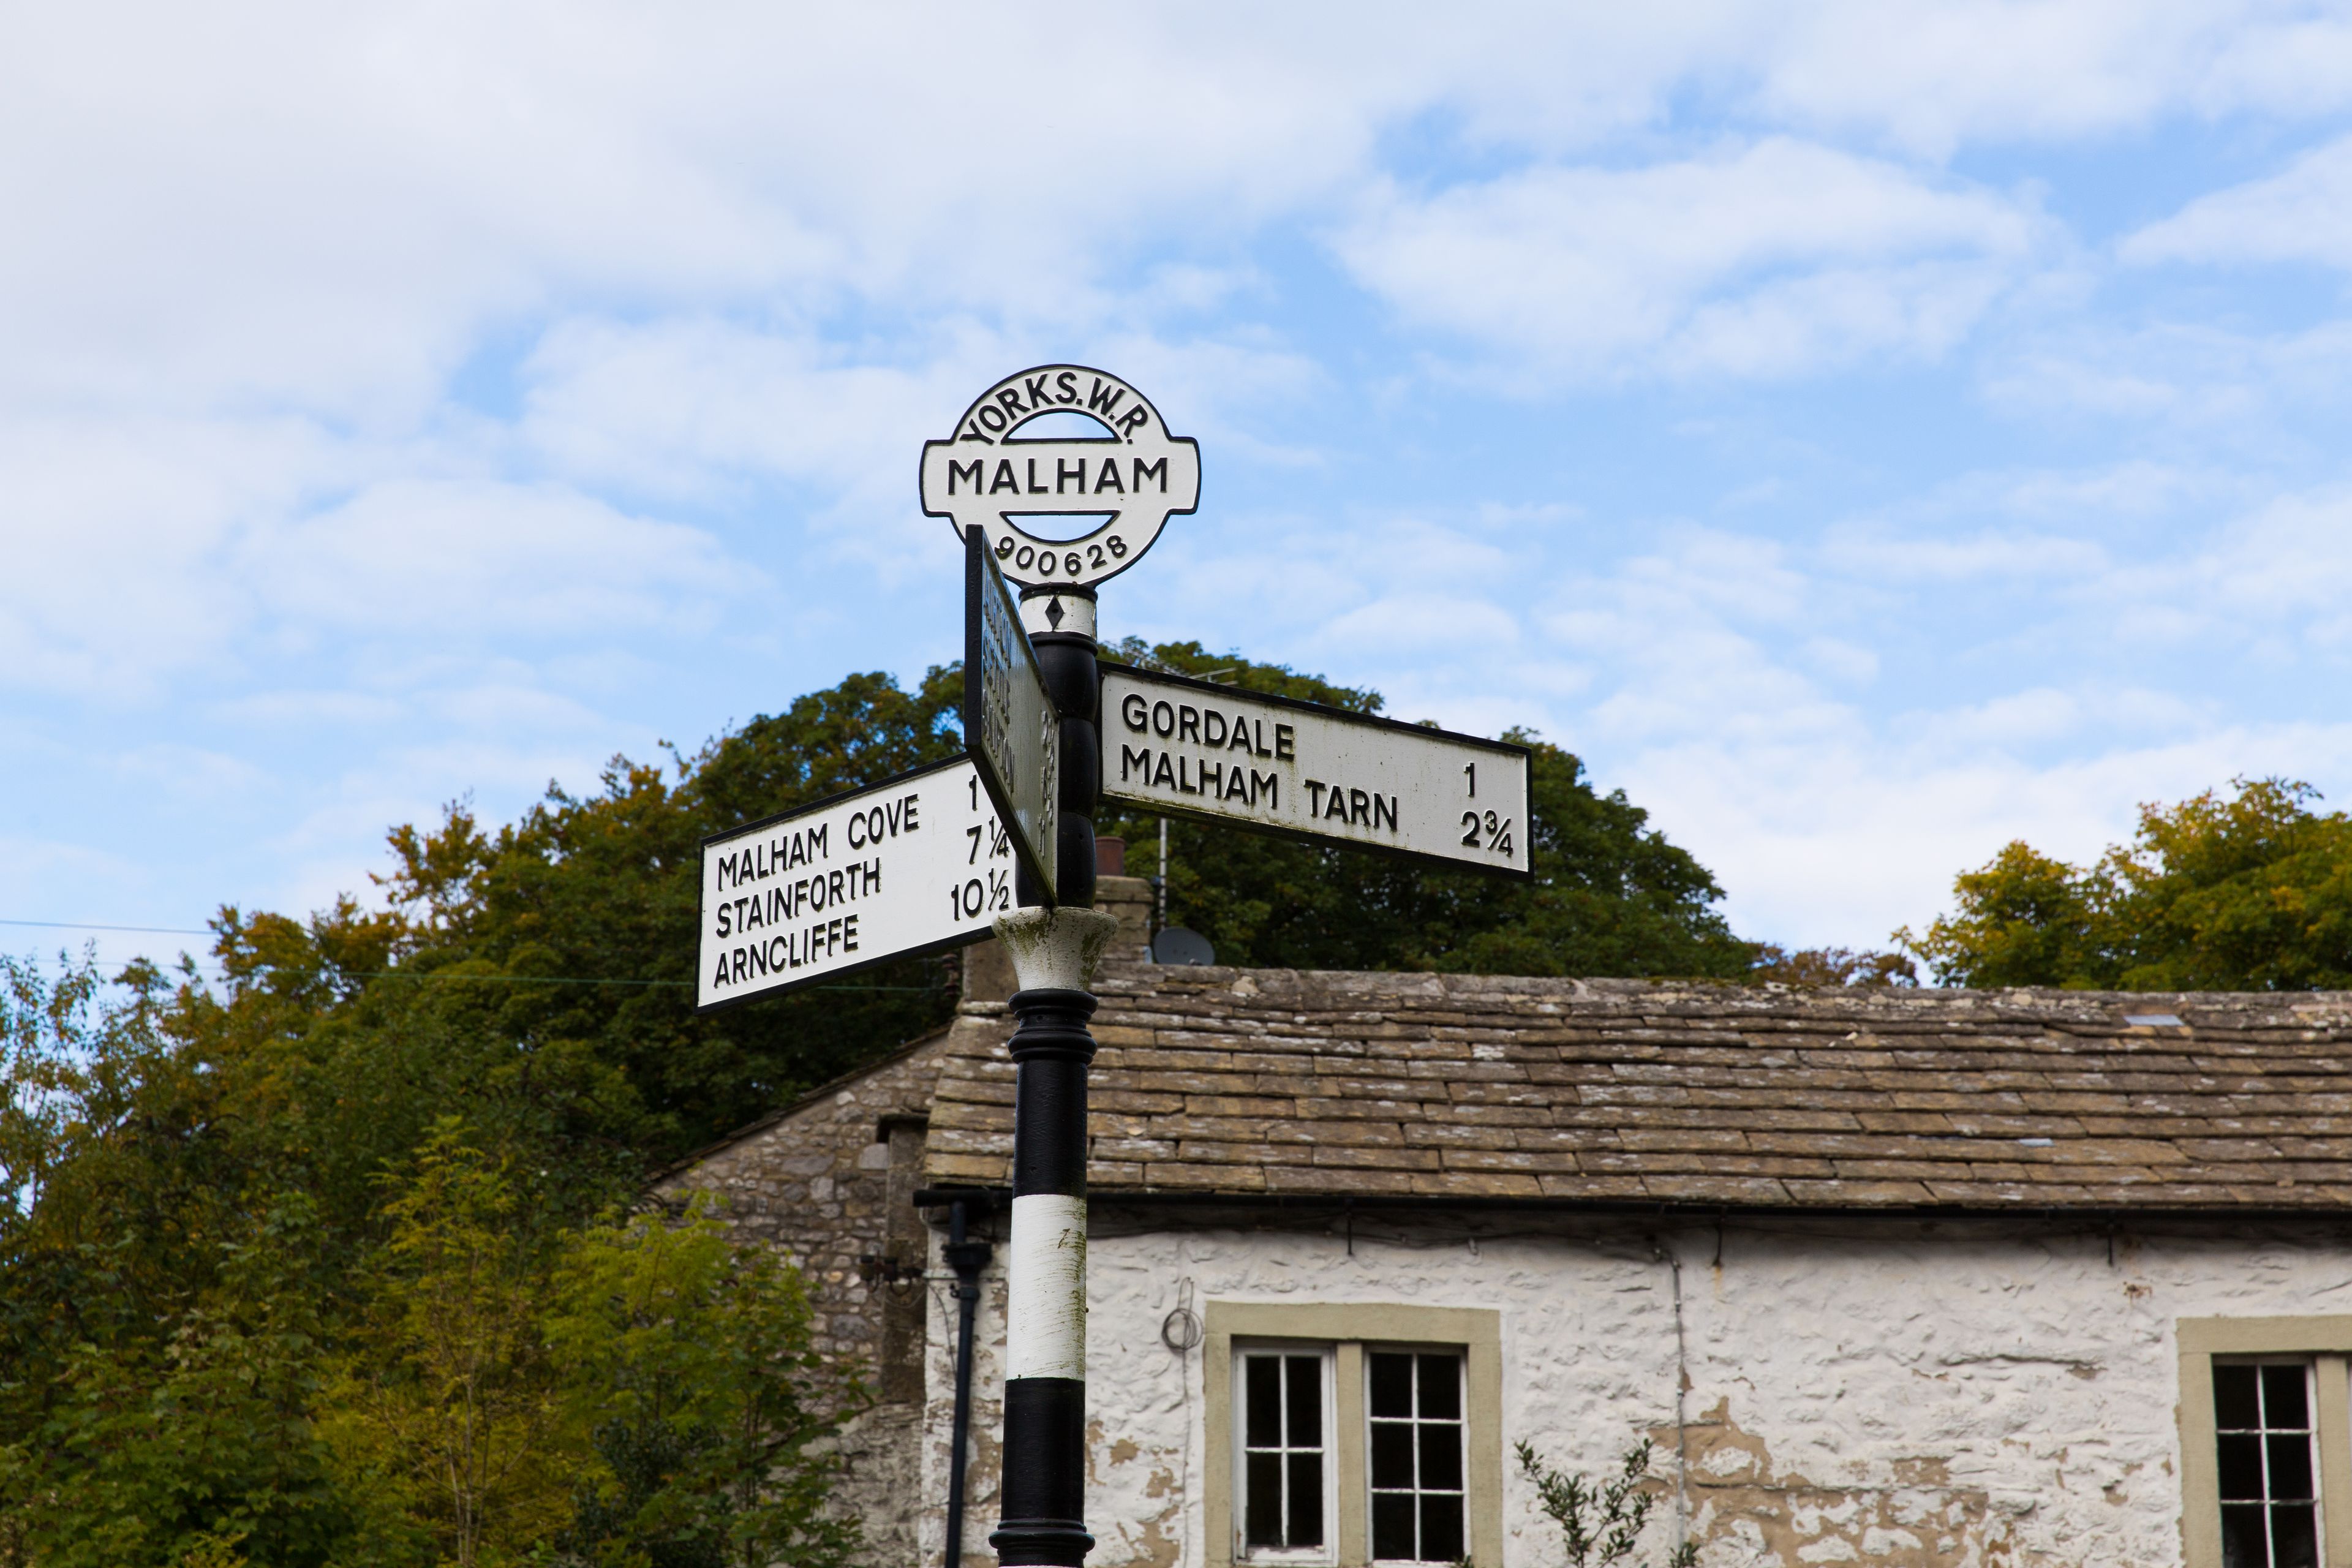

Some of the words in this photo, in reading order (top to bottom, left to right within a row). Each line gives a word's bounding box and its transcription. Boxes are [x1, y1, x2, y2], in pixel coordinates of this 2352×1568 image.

[948, 457, 1167, 495] MALHAM
[994, 535, 1127, 576] 900628
[982, 628, 1011, 723] SETTLE
[981, 690, 1015, 794] SKIPTON
[1121, 693, 1295, 761] GORDALE
[1463, 761, 1475, 797] 1
[1121, 743, 1278, 809] MALHAM
[1303, 778, 1398, 832] TARN
[717, 823, 829, 892] MALHAM
[848, 793, 919, 850] COVE
[969, 774, 978, 812] 1
[715, 856, 881, 939] STAINFORTH
[714, 913, 859, 989] ARNCLIFFE
